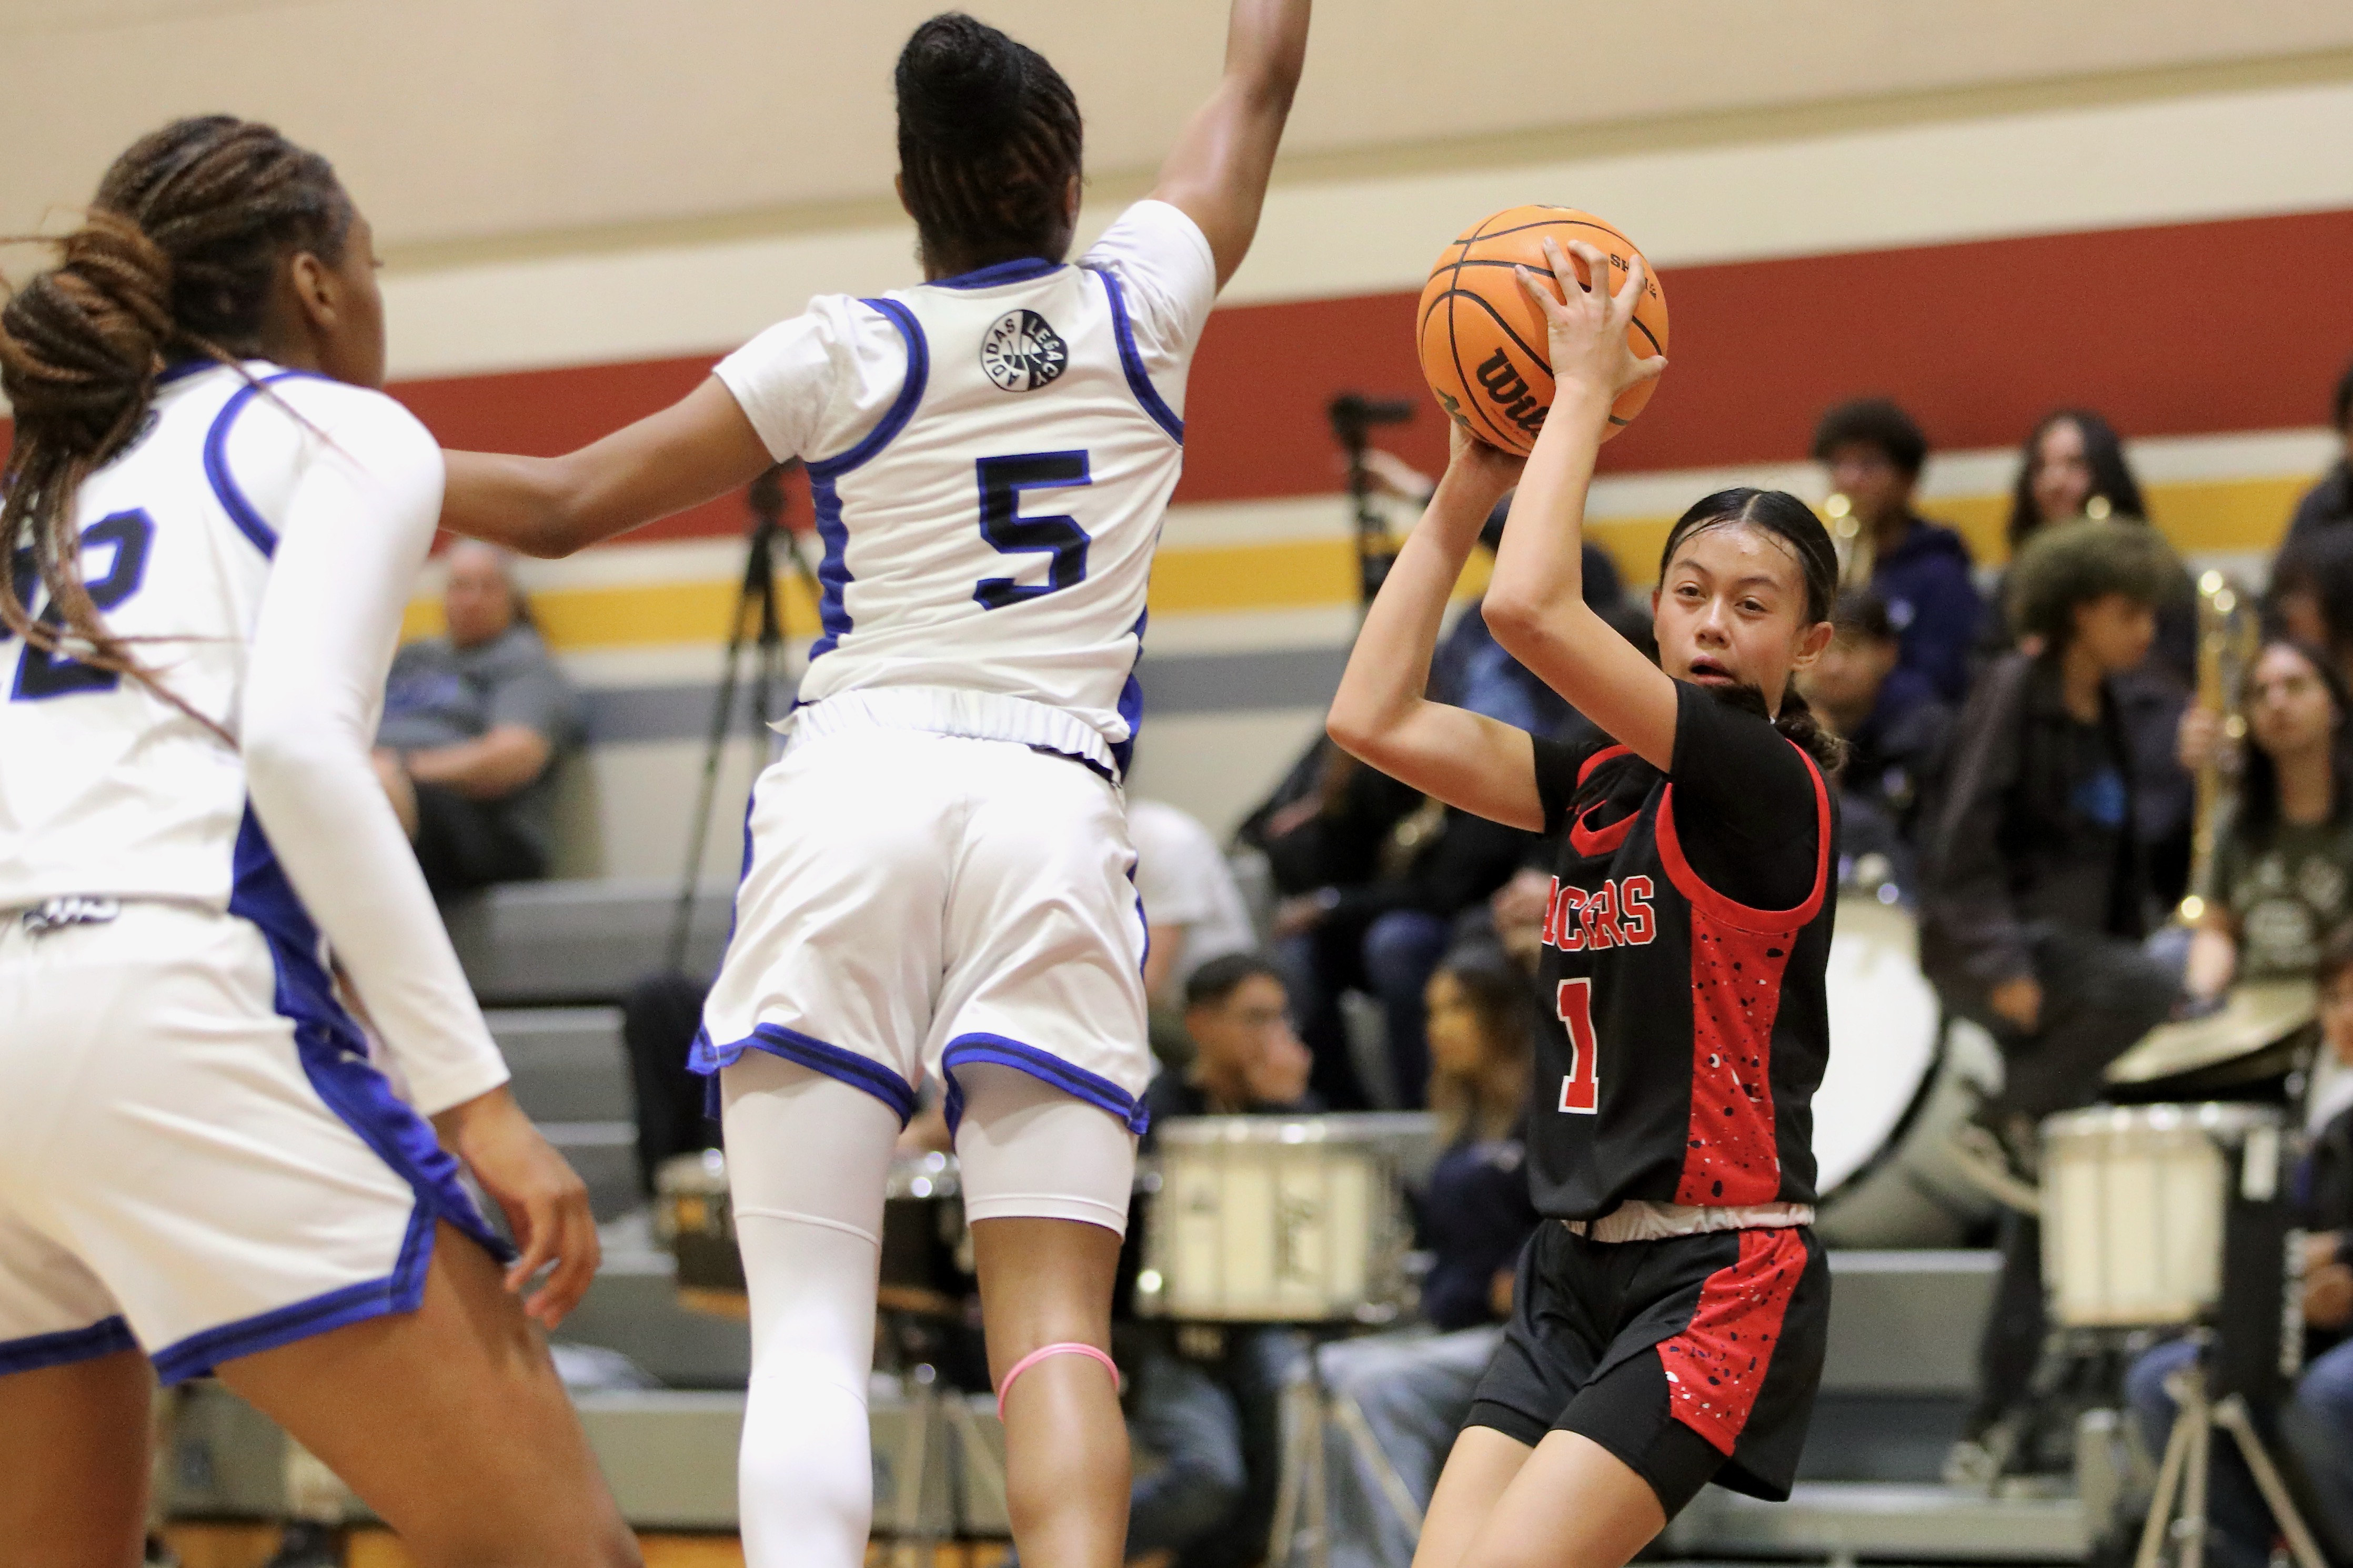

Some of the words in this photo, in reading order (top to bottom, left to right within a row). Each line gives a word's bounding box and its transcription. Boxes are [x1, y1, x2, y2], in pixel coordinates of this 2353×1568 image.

[986, 318, 1020, 387] ADIDAS
[1027, 317, 1064, 387] LEGACY
[1476, 346, 1550, 440] Wil
[972, 449, 1092, 611] 5
[0, 507, 159, 703] 2
[1556, 977, 1599, 1115] 1
